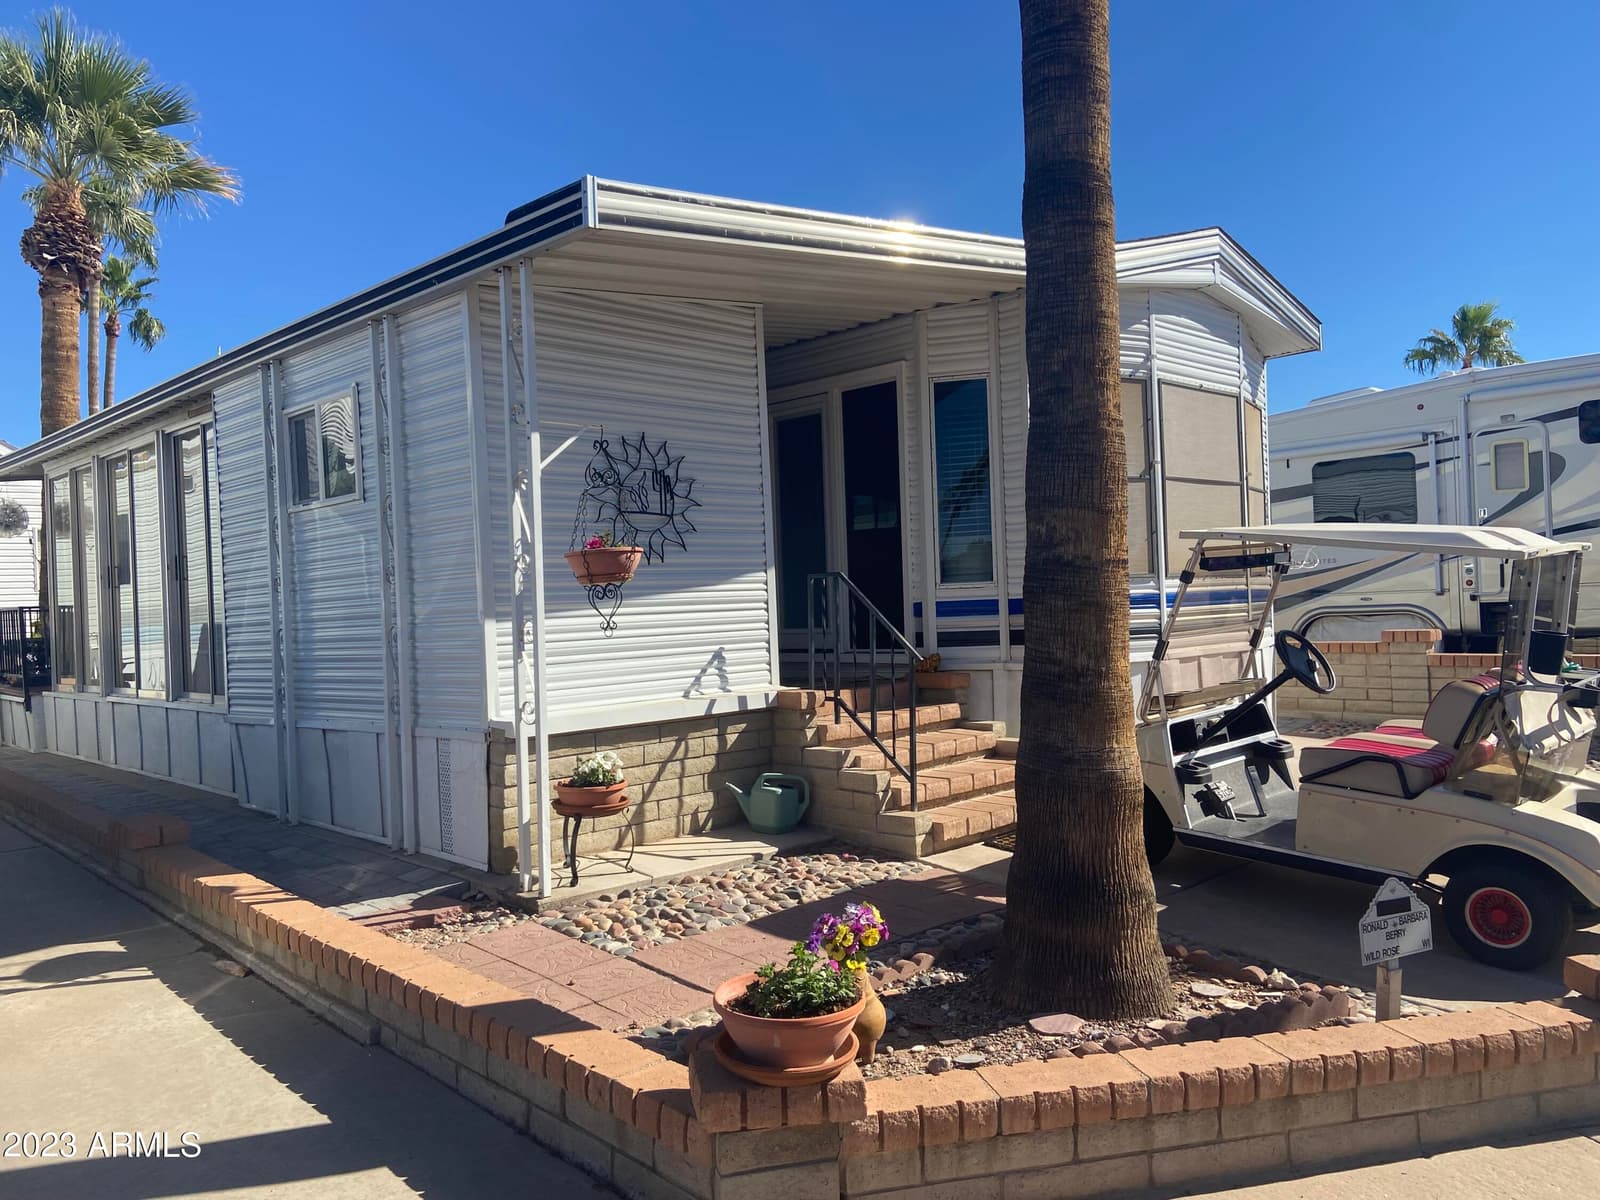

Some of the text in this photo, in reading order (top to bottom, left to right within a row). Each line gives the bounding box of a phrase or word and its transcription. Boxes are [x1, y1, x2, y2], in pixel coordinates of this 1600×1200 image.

[1362, 911, 1428, 934] RONALD BARBARA
[1385, 929, 1406, 940] BERRY
[1364, 950, 1381, 962] WILD
[1382, 946, 1400, 958] ROSE
